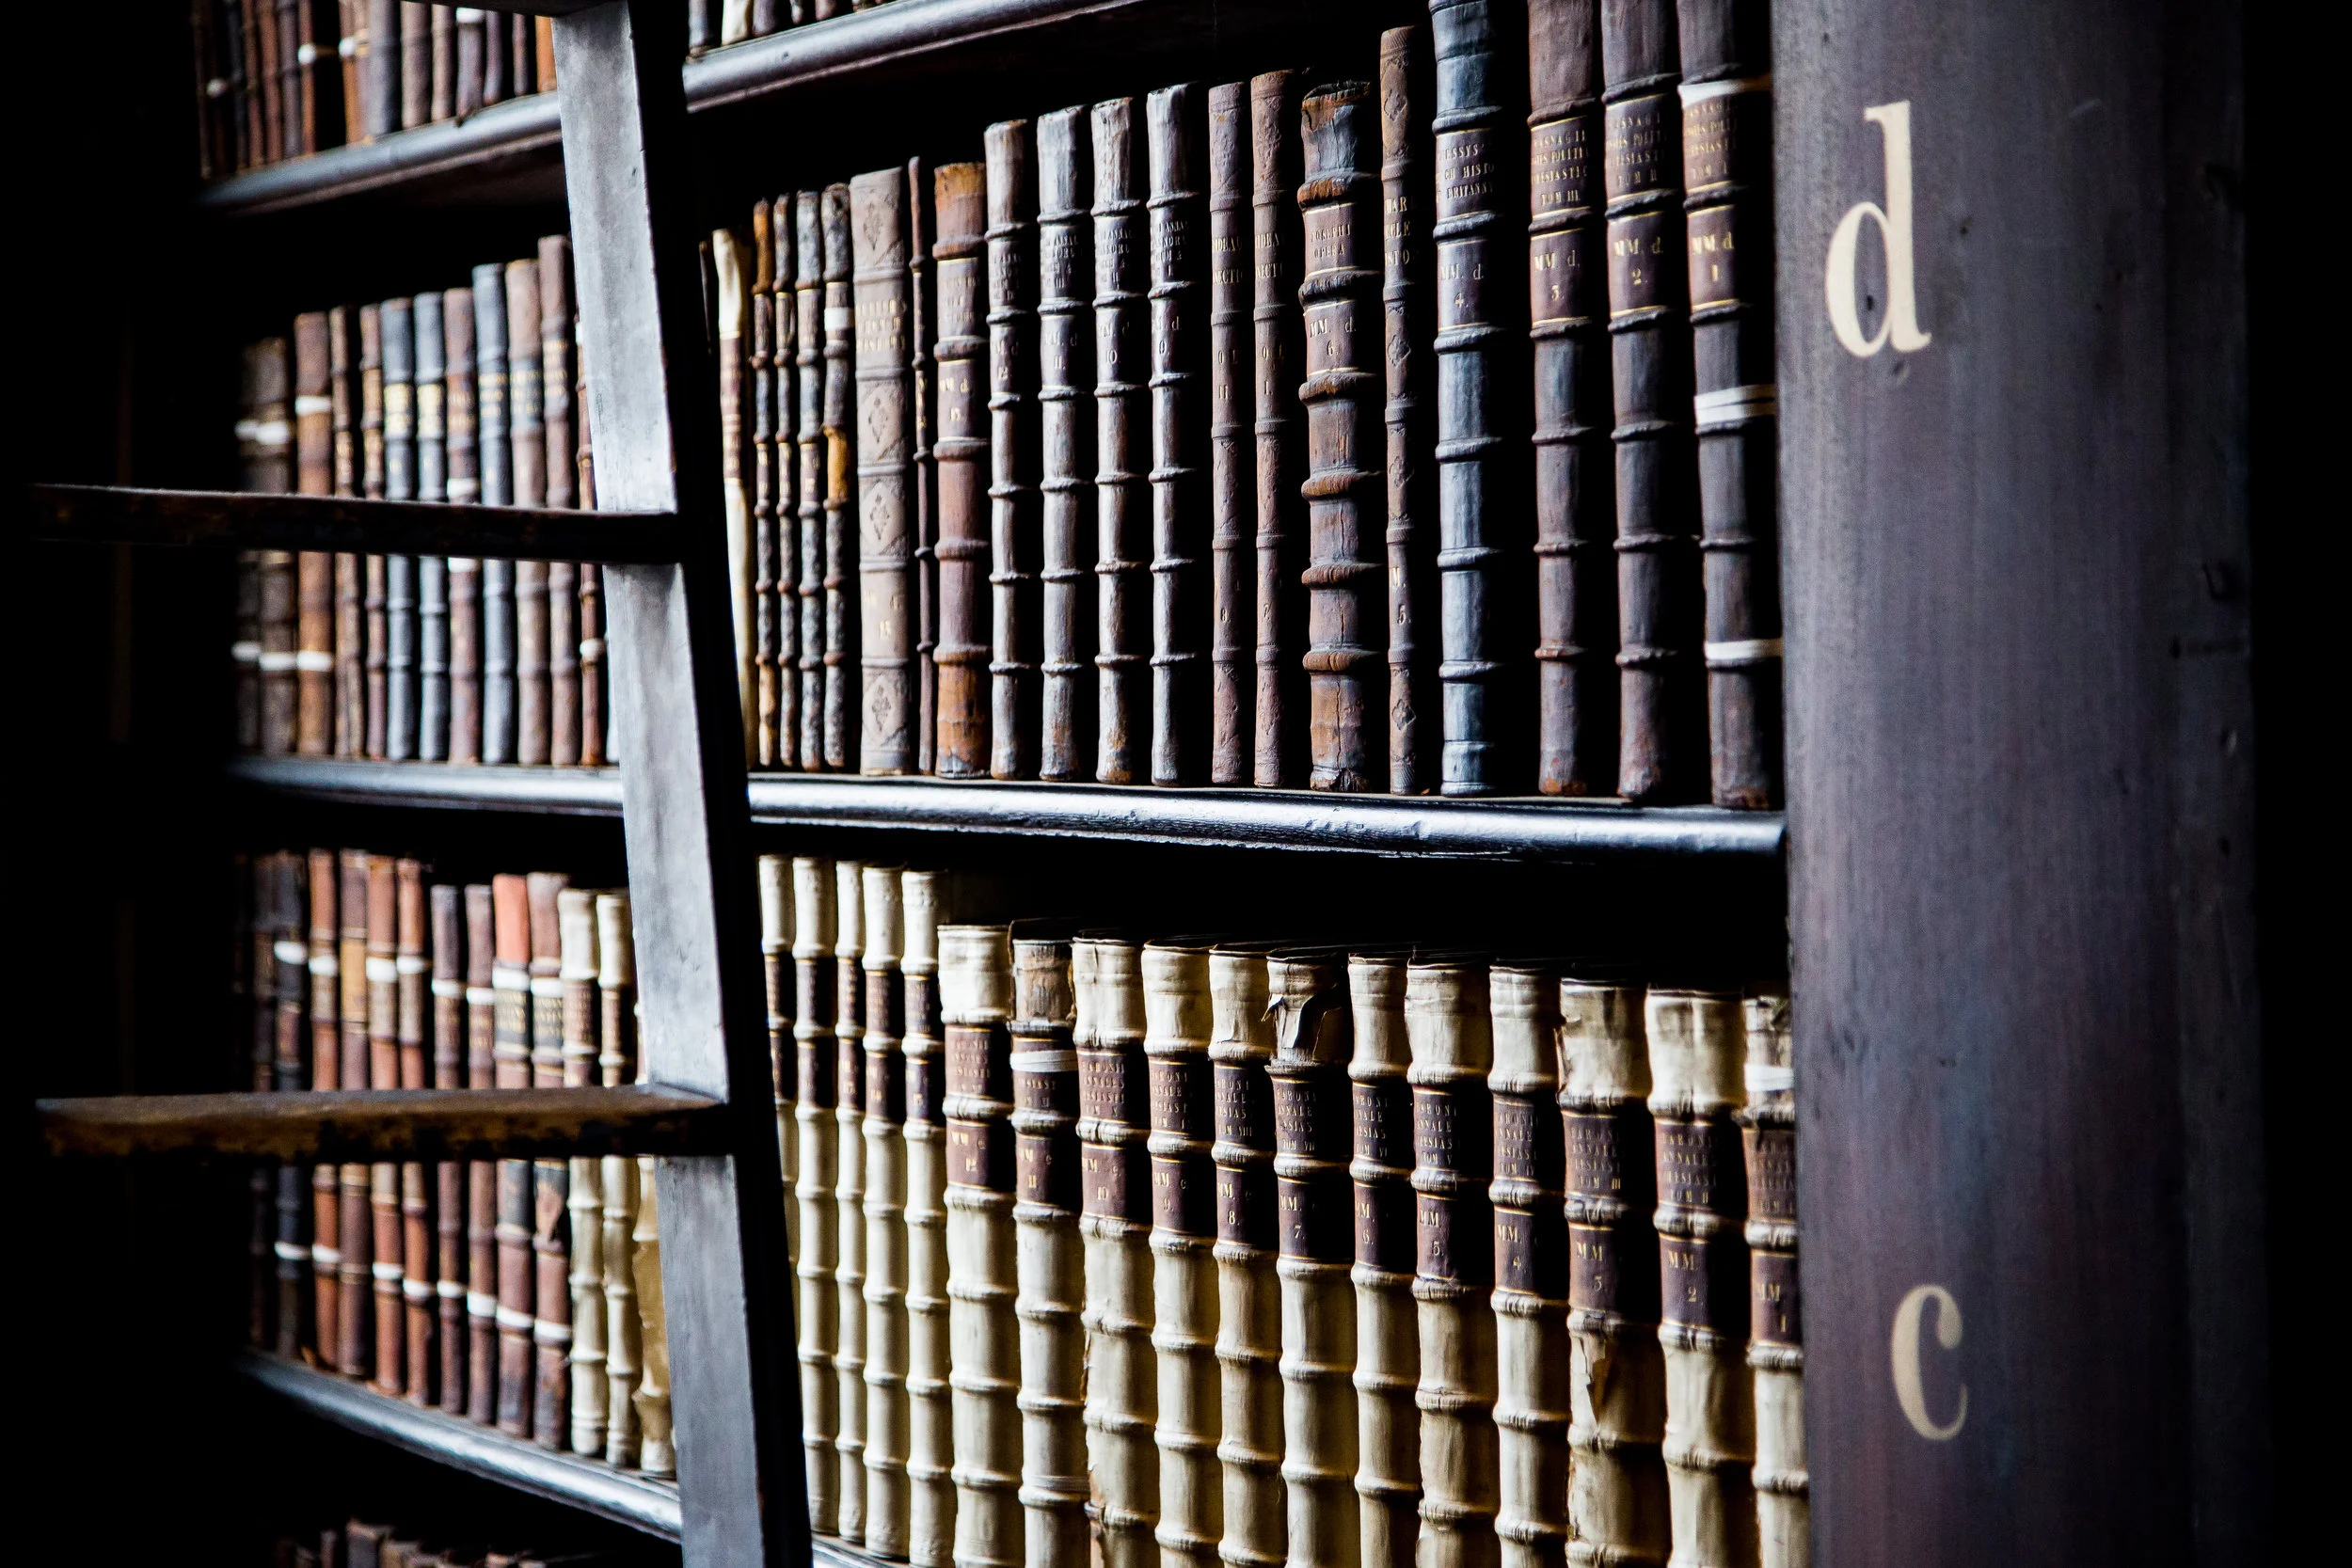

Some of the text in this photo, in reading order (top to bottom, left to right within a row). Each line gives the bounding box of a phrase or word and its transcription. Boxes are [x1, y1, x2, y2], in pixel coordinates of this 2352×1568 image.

[1824, 100, 1931, 358] d
[1471, 263, 1485, 280] d.
[1343, 315, 1358, 333] d.
[1227, 1210, 1241, 1227] 8.
[1361, 1229, 1375, 1245] 6.
[1431, 1240, 1445, 1257] 5.
[1891, 1284, 1968, 1441] c
